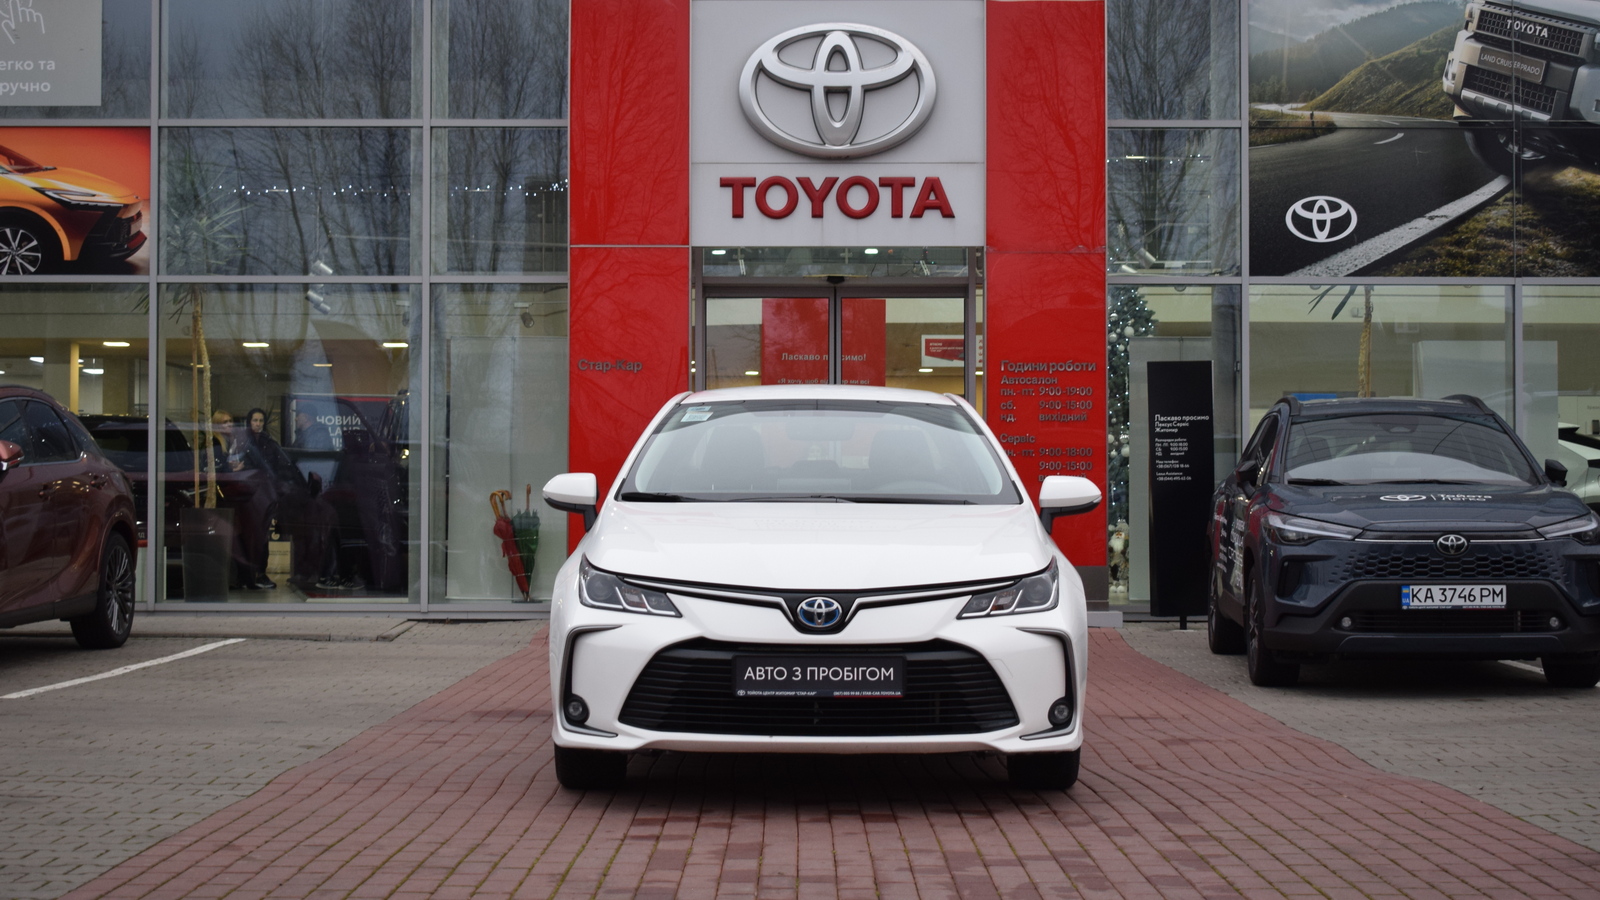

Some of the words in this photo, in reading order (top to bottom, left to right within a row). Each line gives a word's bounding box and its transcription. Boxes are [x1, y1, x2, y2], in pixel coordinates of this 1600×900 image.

[1506, 19, 1548, 38] TOYOTA
[38, 60, 56, 71] та
[1480, 53, 1496, 64] LAND
[1496, 57, 1522, 70] CRUISER
[1520, 63, 1541, 75] PRADO
[719, 175, 955, 220] TOYOTA
[781, 353, 820, 361] Ласкаво
[822, 353, 867, 361] псимо!
[578, 359, 643, 374] Стар-Кар
[1000, 360, 1048, 373] Години
[1049, 360, 1096, 374] роботи
[1000, 375, 1058, 385] Автосалон
[1039, 386, 1093, 396] 9:00-19:00
[1000, 400, 1016, 410] сб.
[1039, 400, 1093, 410] 9:00-15:00
[1000, 413, 1016, 422] нд.
[1039, 411, 1087, 422] вихідний
[1154, 414, 1182, 422] Ласкаво
[1000, 433, 1035, 445] Сервіс
[1039, 447, 1093, 457] 9:00-18:00
[1039, 461, 1093, 470] 9:00-15:00
[1438, 587, 1477, 603] 3746
[743, 666, 788, 681] АВТО
[806, 666, 894, 681] ПРОБІГОМ
